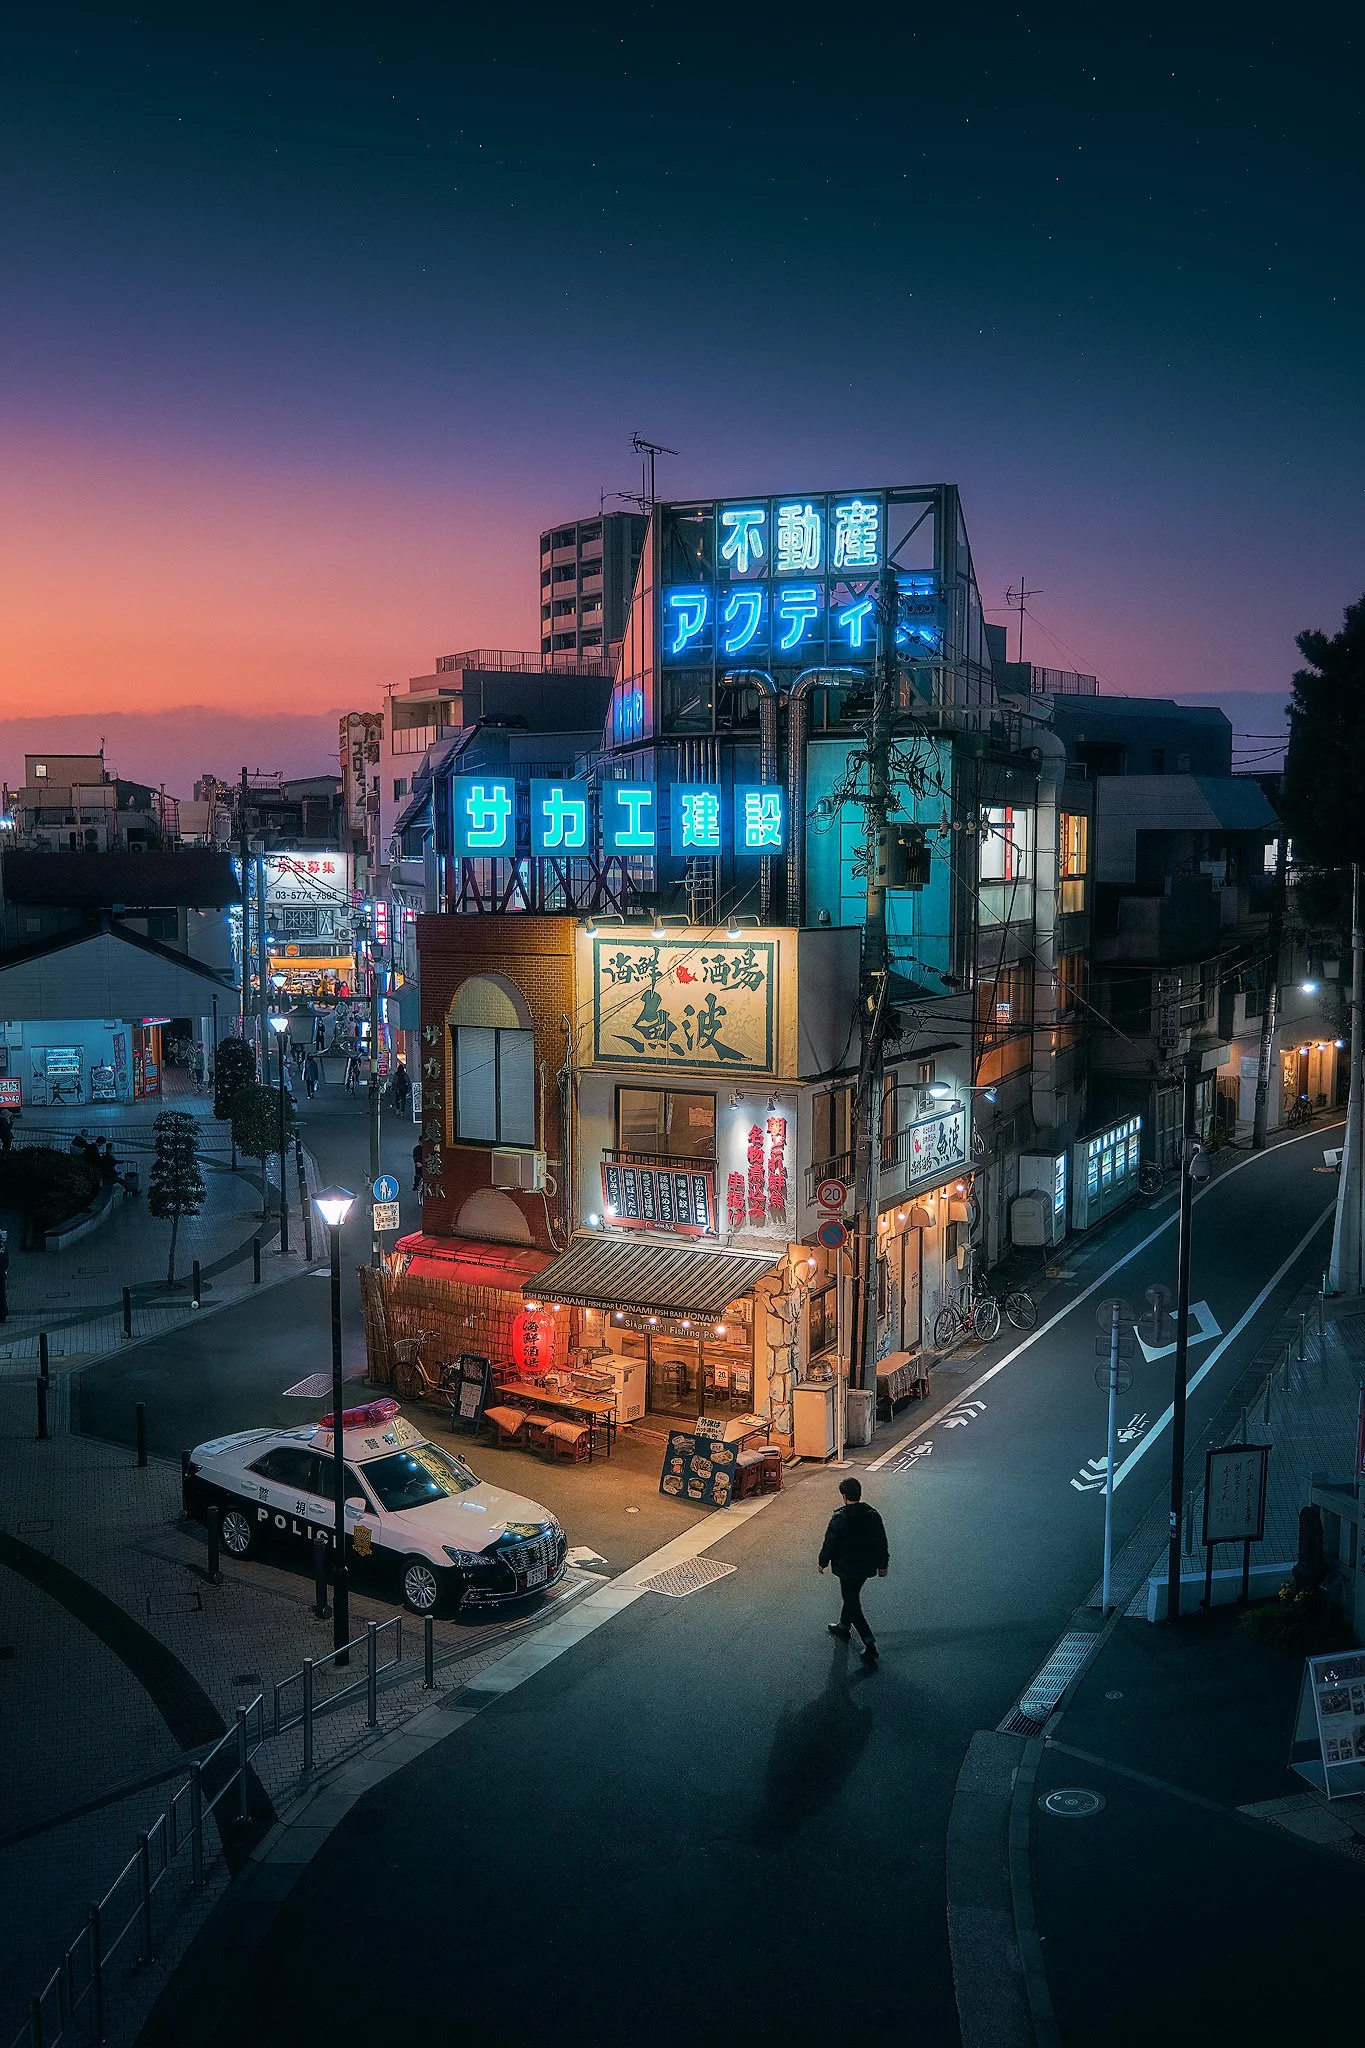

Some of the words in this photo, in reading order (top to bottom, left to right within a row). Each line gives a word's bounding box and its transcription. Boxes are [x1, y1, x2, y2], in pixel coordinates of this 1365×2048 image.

[721, 500, 878, 574] 不動産
[277, 860, 335, 873] 広告募集
[611, 989, 753, 1061] 魚波
[747, 1124, 767, 1219] 名物煮込み
[727, 1171, 746, 1227] 串揚げ
[823, 1188, 842, 1201] 20
[523, 1292, 537, 1300] FISH
[550, 1295, 586, 1306] UONAMI
[587, 1300, 602, 1308] FISH
[602, 1302, 615, 1310] BAR
[615, 1303, 653, 1315] UONAMI
[654, 1308, 669, 1317] FISH
[669, 1310, 683, 1319] BAR
[669, 1325, 700, 1340] Fishing
